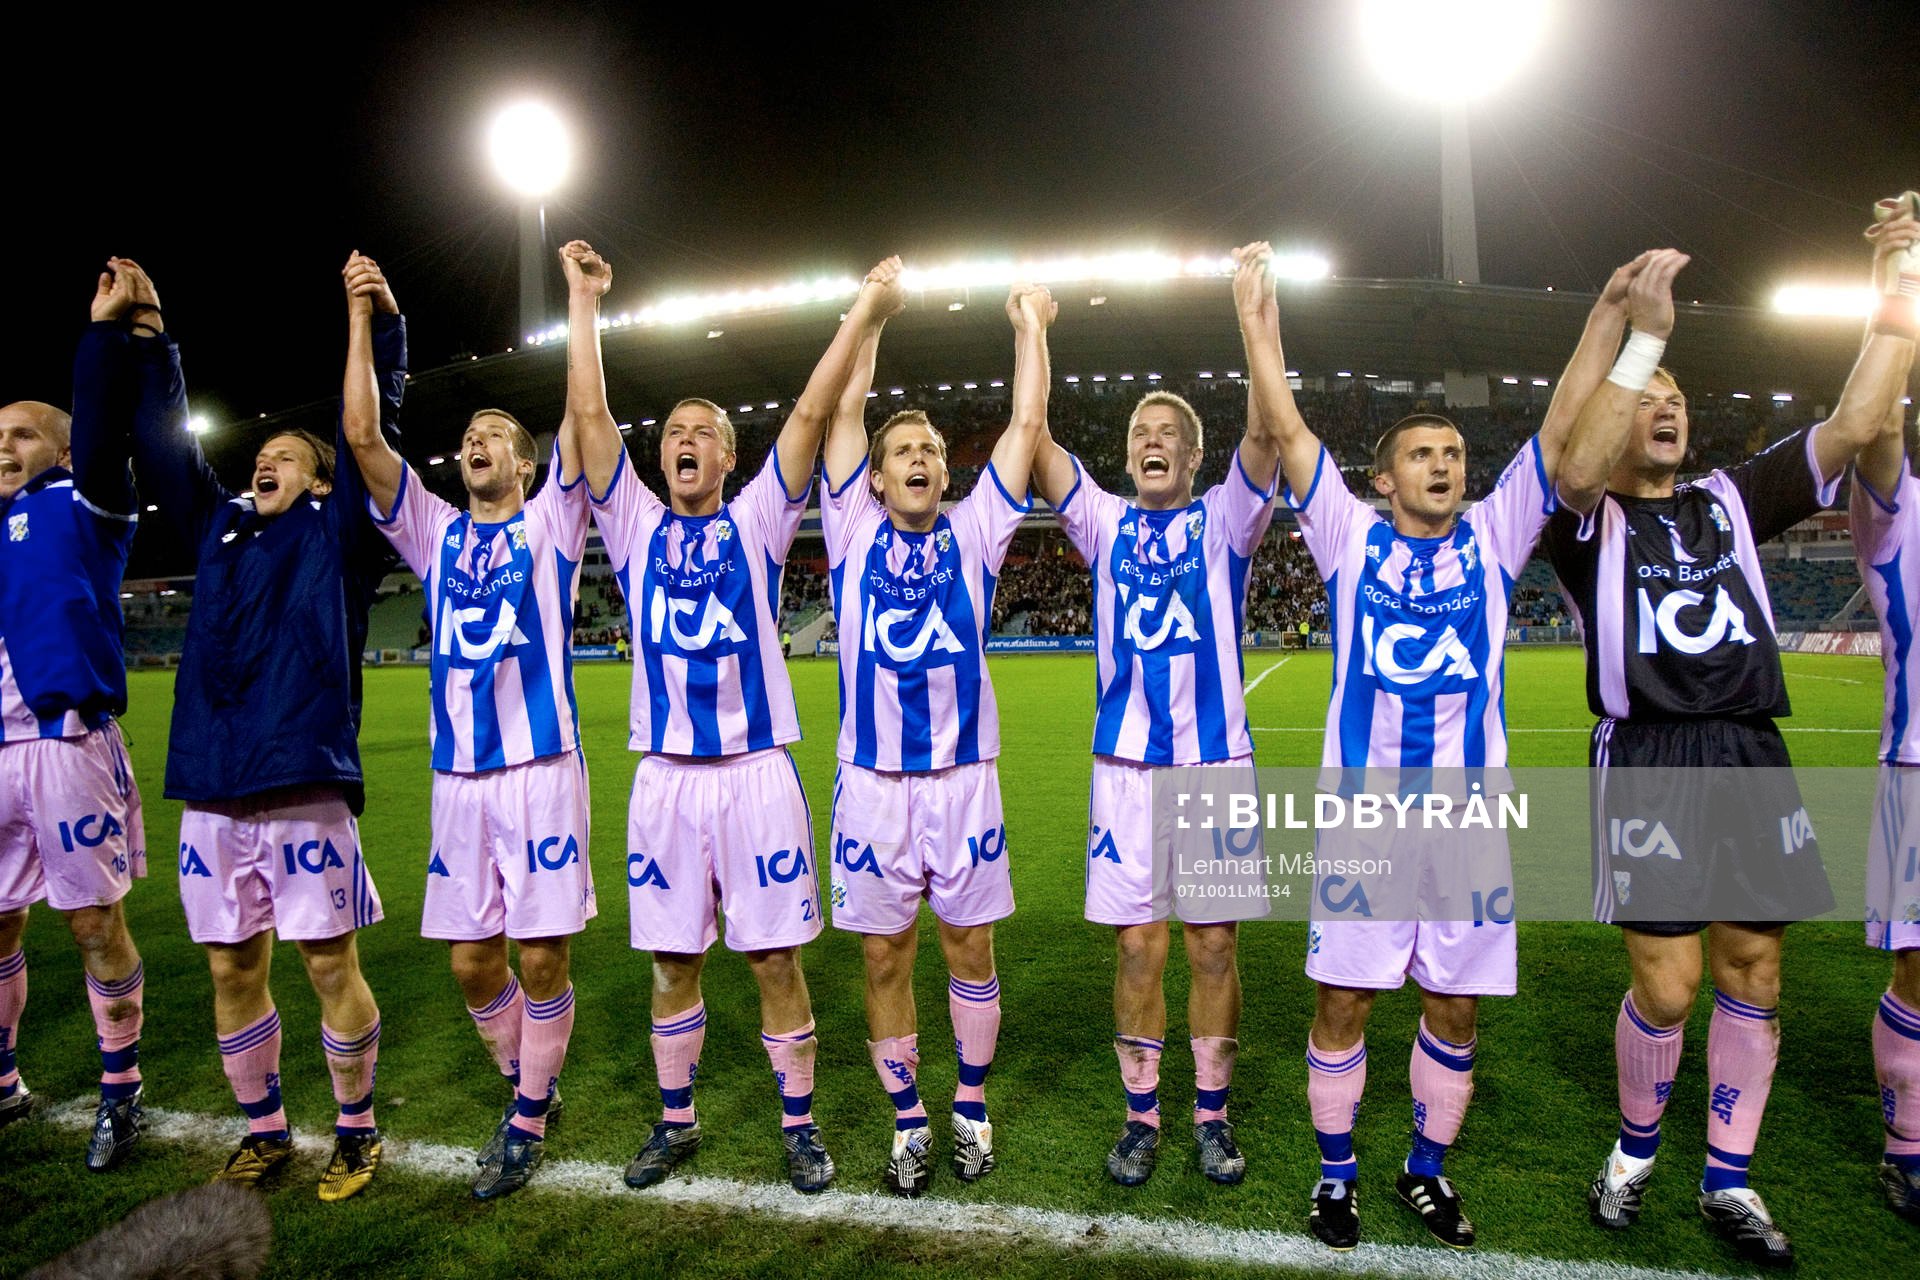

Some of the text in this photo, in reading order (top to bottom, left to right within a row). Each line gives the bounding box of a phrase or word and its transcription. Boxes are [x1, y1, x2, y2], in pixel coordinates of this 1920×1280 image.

[471, 568, 525, 600] Bande
[1364, 584, 1402, 609] Rosa
[439, 597, 531, 661] ICA
[651, 585, 749, 651] ICA
[864, 593, 967, 663] ICA
[1116, 583, 1202, 651] ICA
[1637, 583, 1758, 655] ICA
[1361, 611, 1480, 685] ICA
[58, 812, 123, 853] ICA
[1611, 818, 1683, 860] ICA
[1780, 806, 1817, 855] ICA
[112, 853, 127, 876] 18
[283, 837, 345, 875] ICA
[755, 846, 809, 888] ICA
[835, 832, 884, 878] ICA
[331, 888, 346, 910] 13
[1711, 1082, 1741, 1126] SKF
